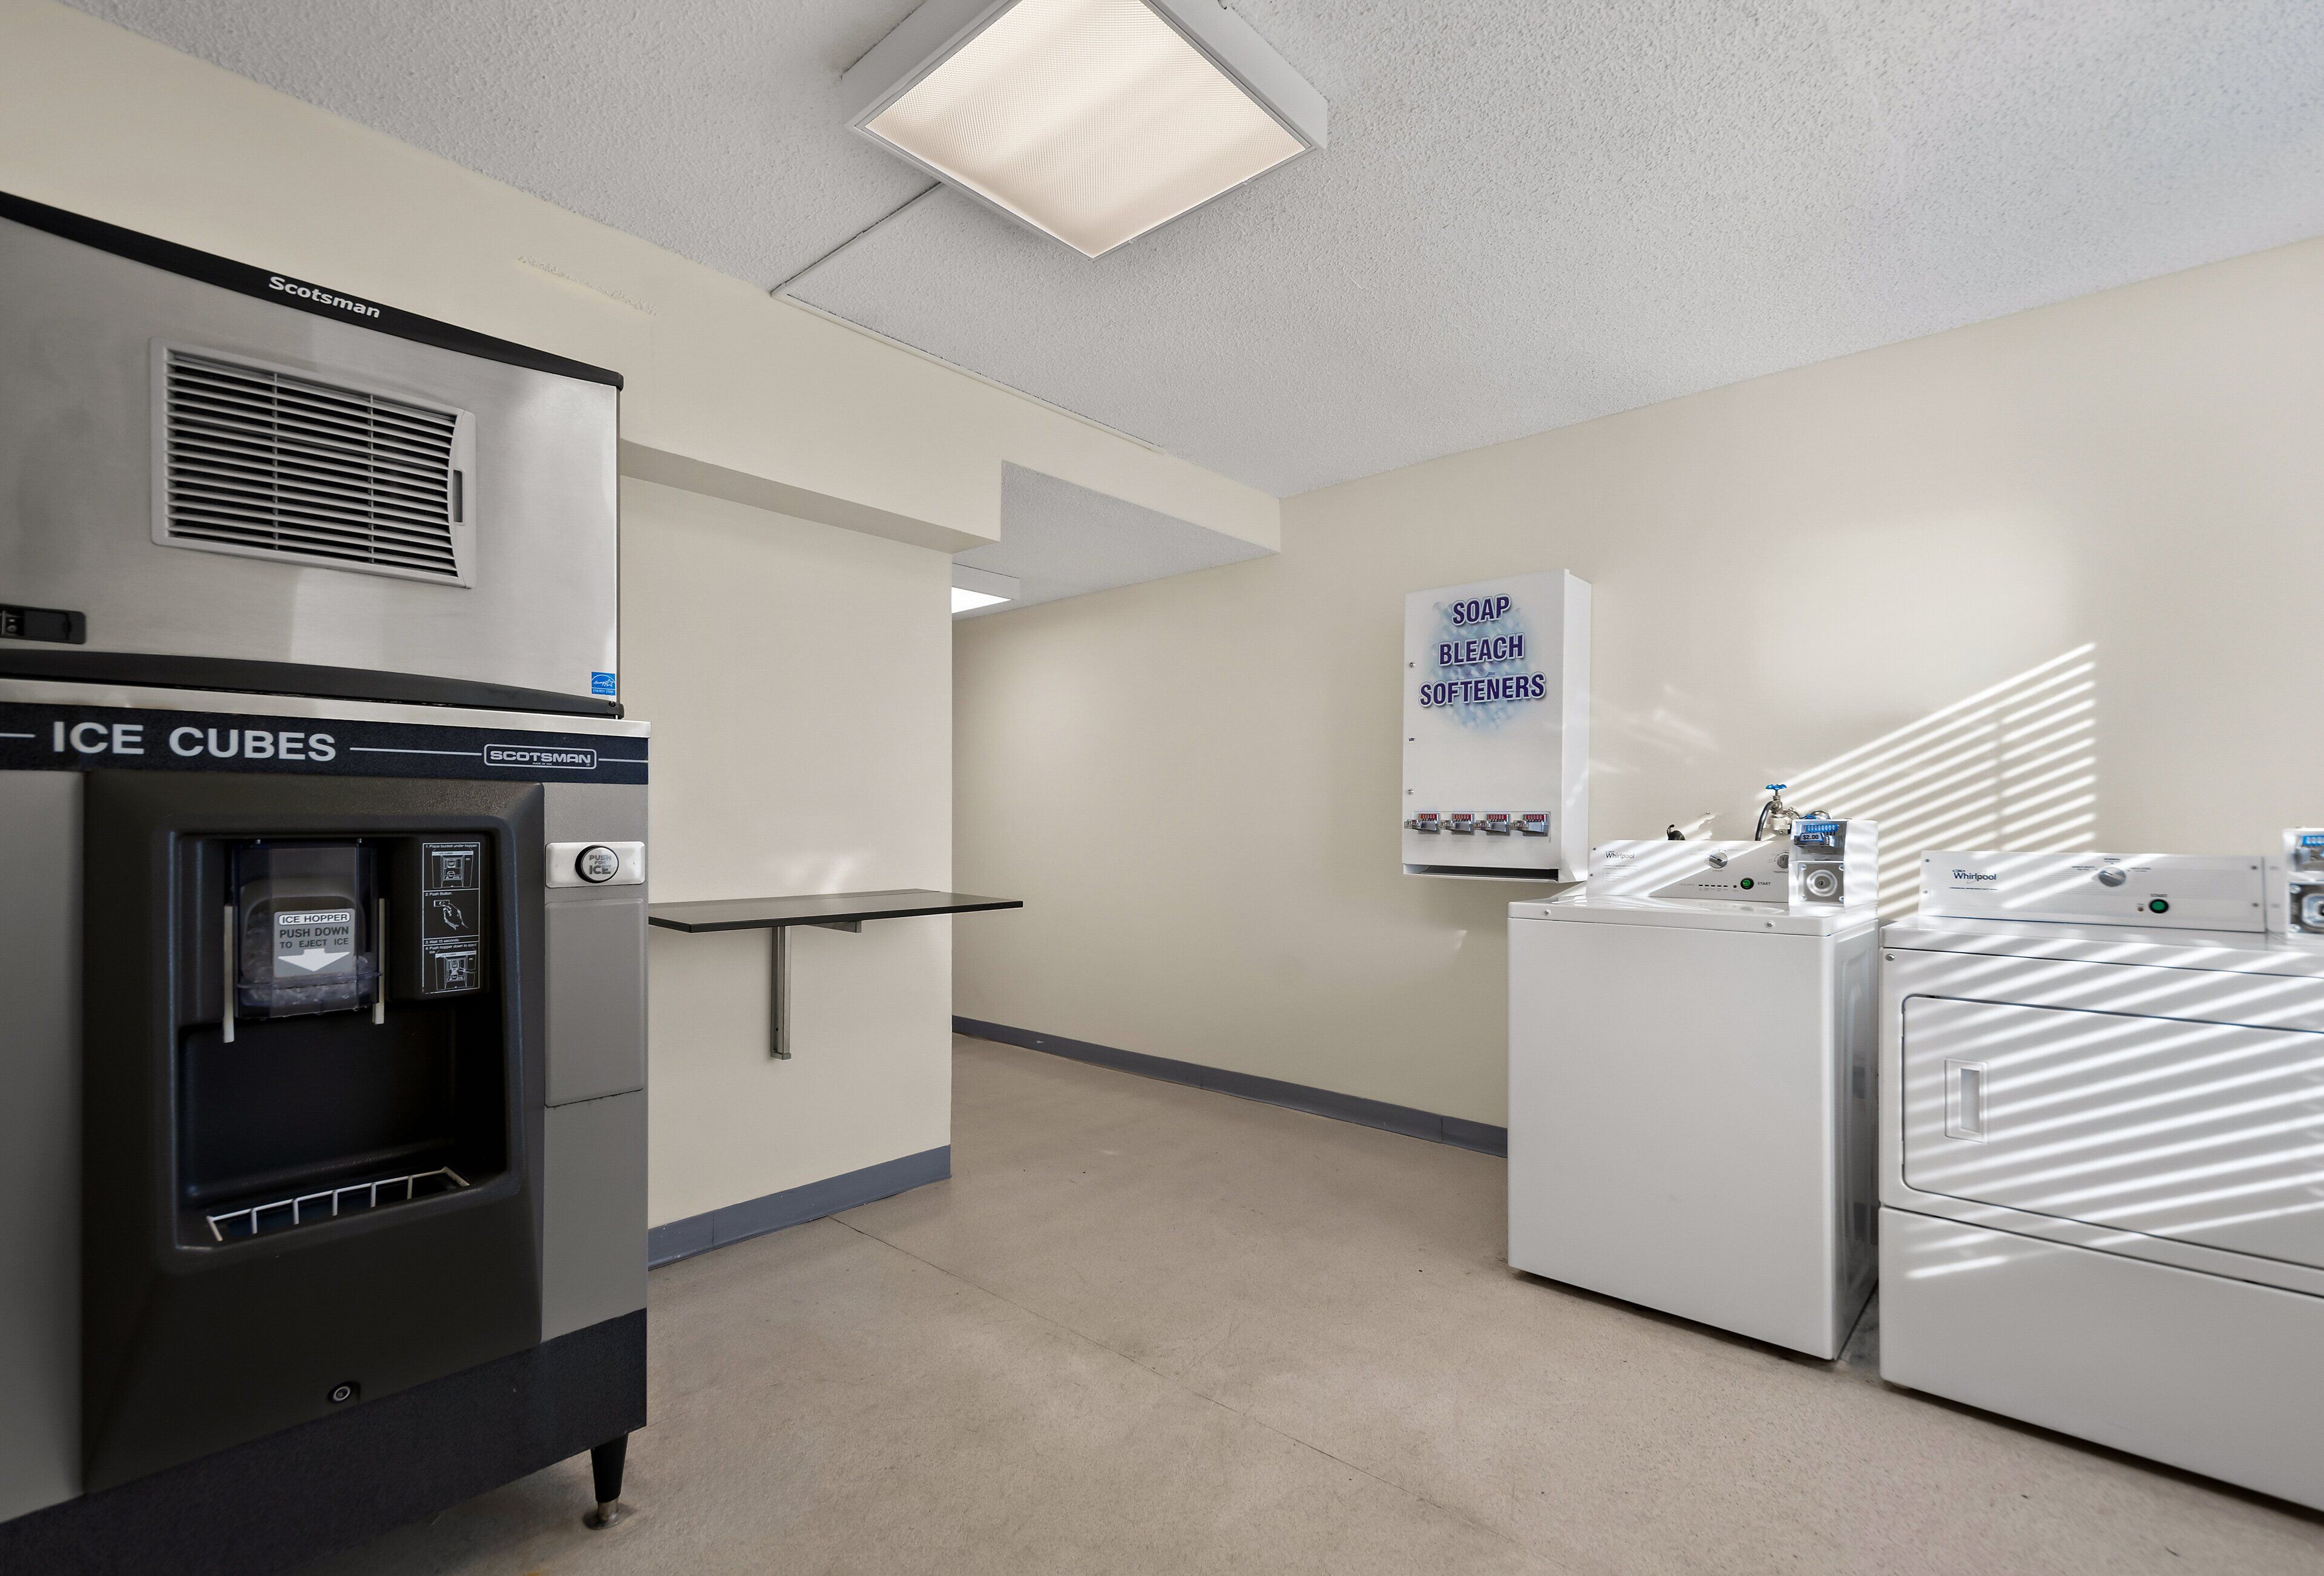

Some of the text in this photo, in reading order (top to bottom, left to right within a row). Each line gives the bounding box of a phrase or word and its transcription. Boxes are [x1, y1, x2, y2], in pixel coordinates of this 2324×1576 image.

[269, 276, 380, 318] Scotsman
[1452, 595, 1511, 625] SOAP
[1439, 634, 1525, 666] BLEACH
[1419, 672, 1546, 706] SOFTENERS
[54, 721, 336, 762] ICE CUBES
[490, 750, 591, 763] SCOTSMAN
[589, 865, 611, 875] ICE
[1954, 872, 1997, 881] Whirlpool
[280, 927, 349, 938] PUSH DOWN
[299, 939, 327, 948] EJECT
